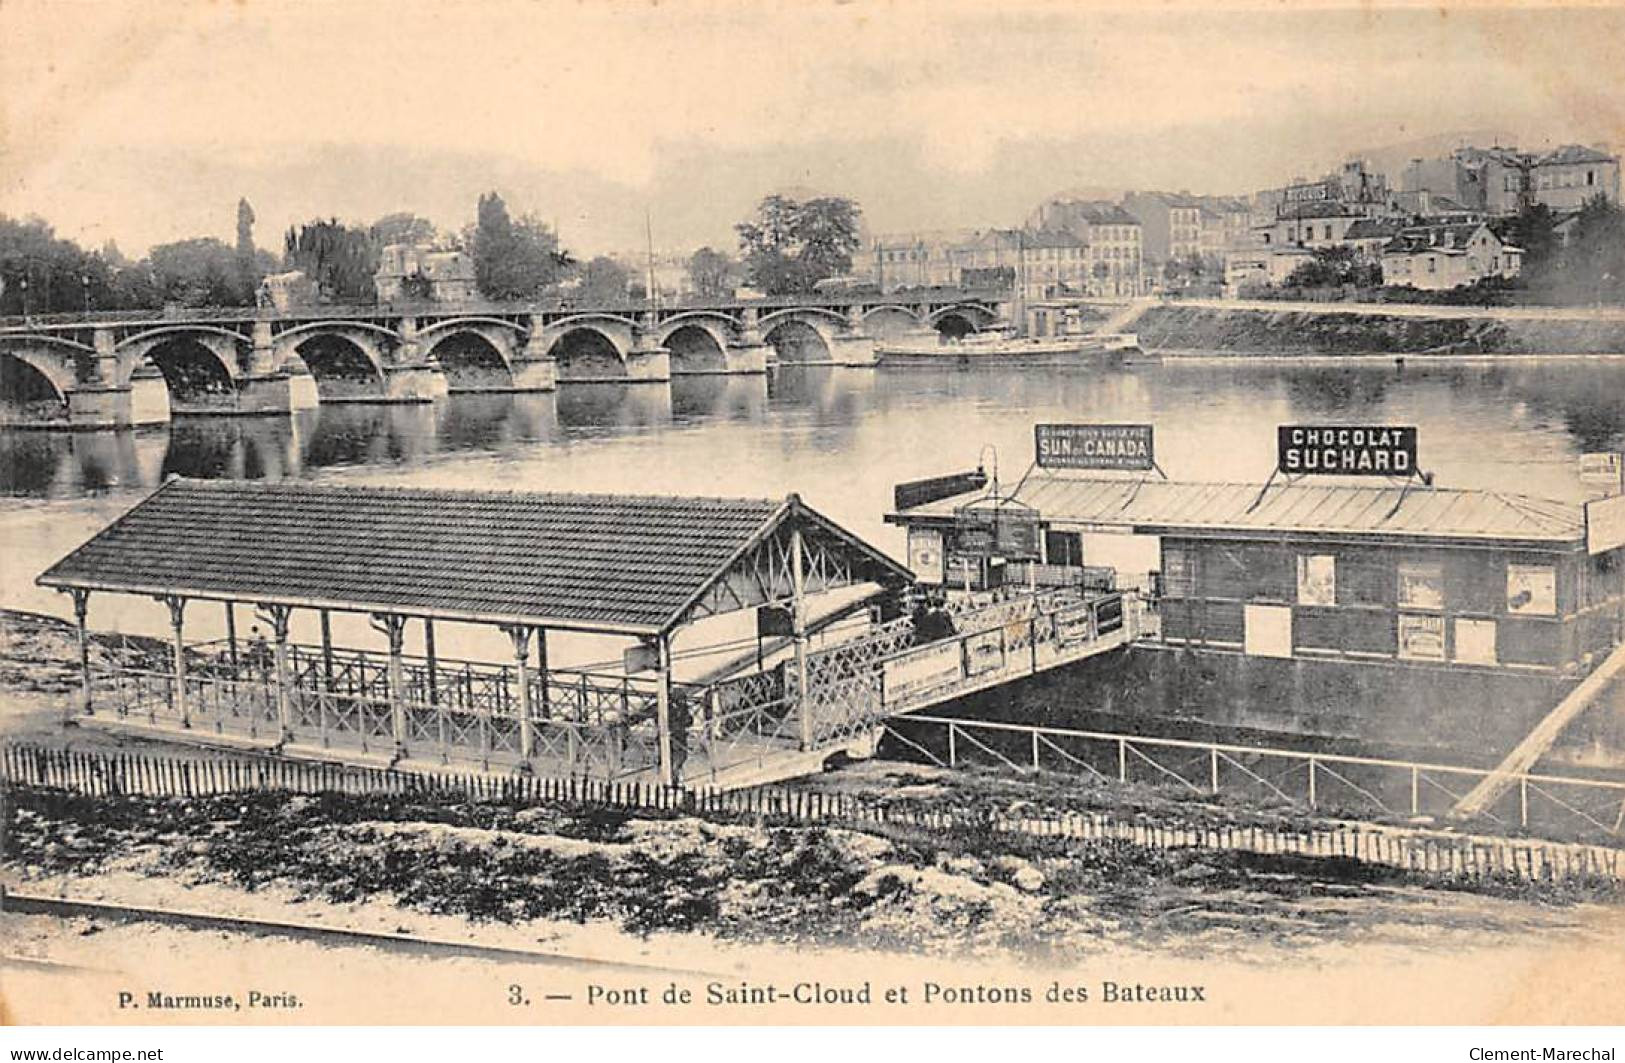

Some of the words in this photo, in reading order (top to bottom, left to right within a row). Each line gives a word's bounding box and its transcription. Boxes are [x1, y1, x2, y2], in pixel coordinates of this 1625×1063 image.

[1292, 429, 1402, 446] CHOCOLAT
[1040, 439, 1071, 455] SUN
[1084, 440, 1147, 457] CANADA
[1286, 448, 1409, 470] SUCHARD
